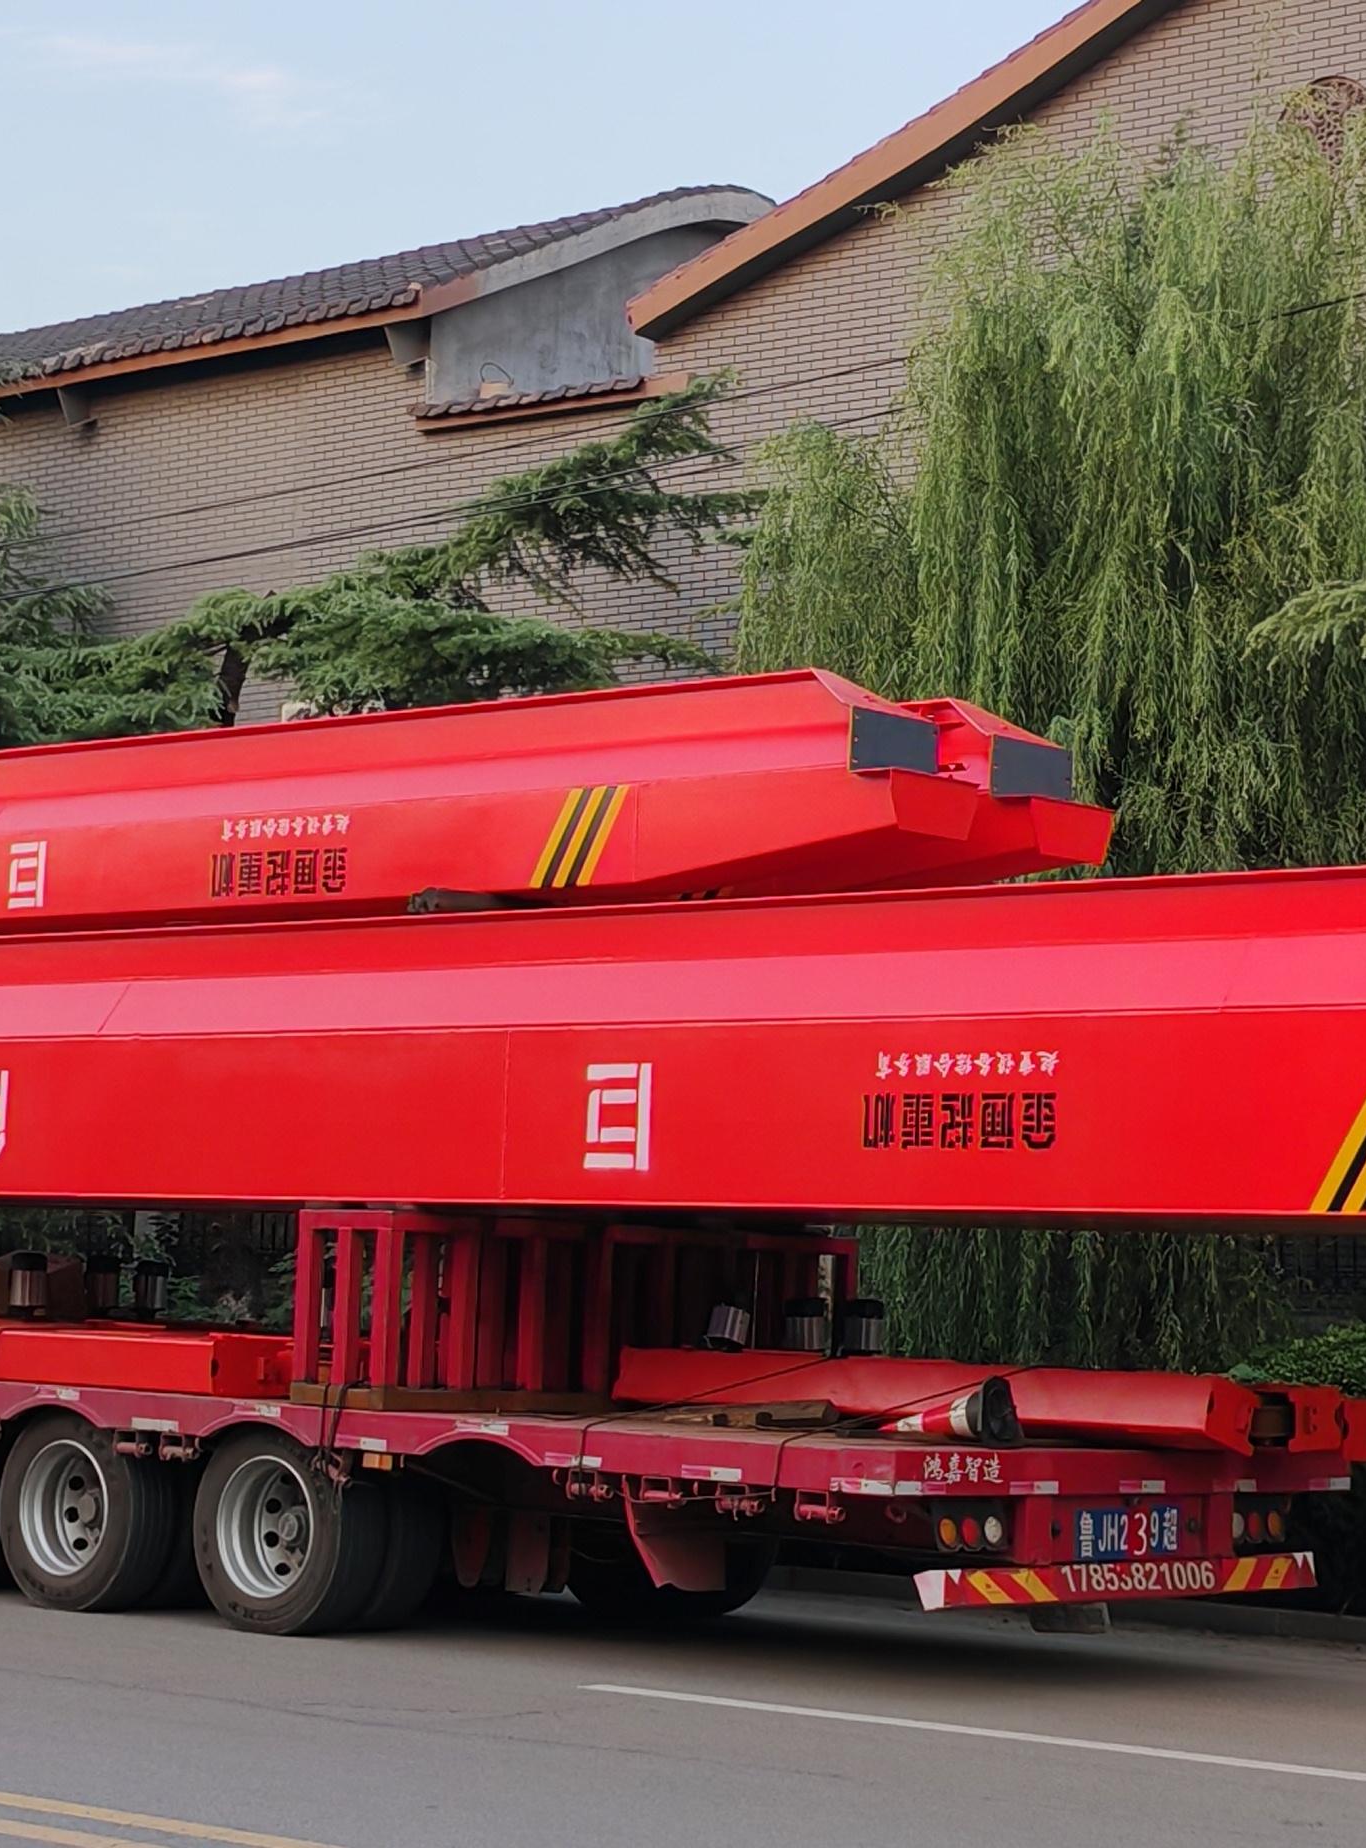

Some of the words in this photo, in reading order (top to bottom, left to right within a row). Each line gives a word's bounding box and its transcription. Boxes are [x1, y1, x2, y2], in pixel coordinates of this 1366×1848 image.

[8, 840, 47, 909] 巨
[211, 847, 348, 898] 金通起重机
[583, 1062, 652, 1172] 巨
[863, 1093, 1055, 1151] 金通起重机
[923, 1452, 1004, 1485] 鸿嘉智造
